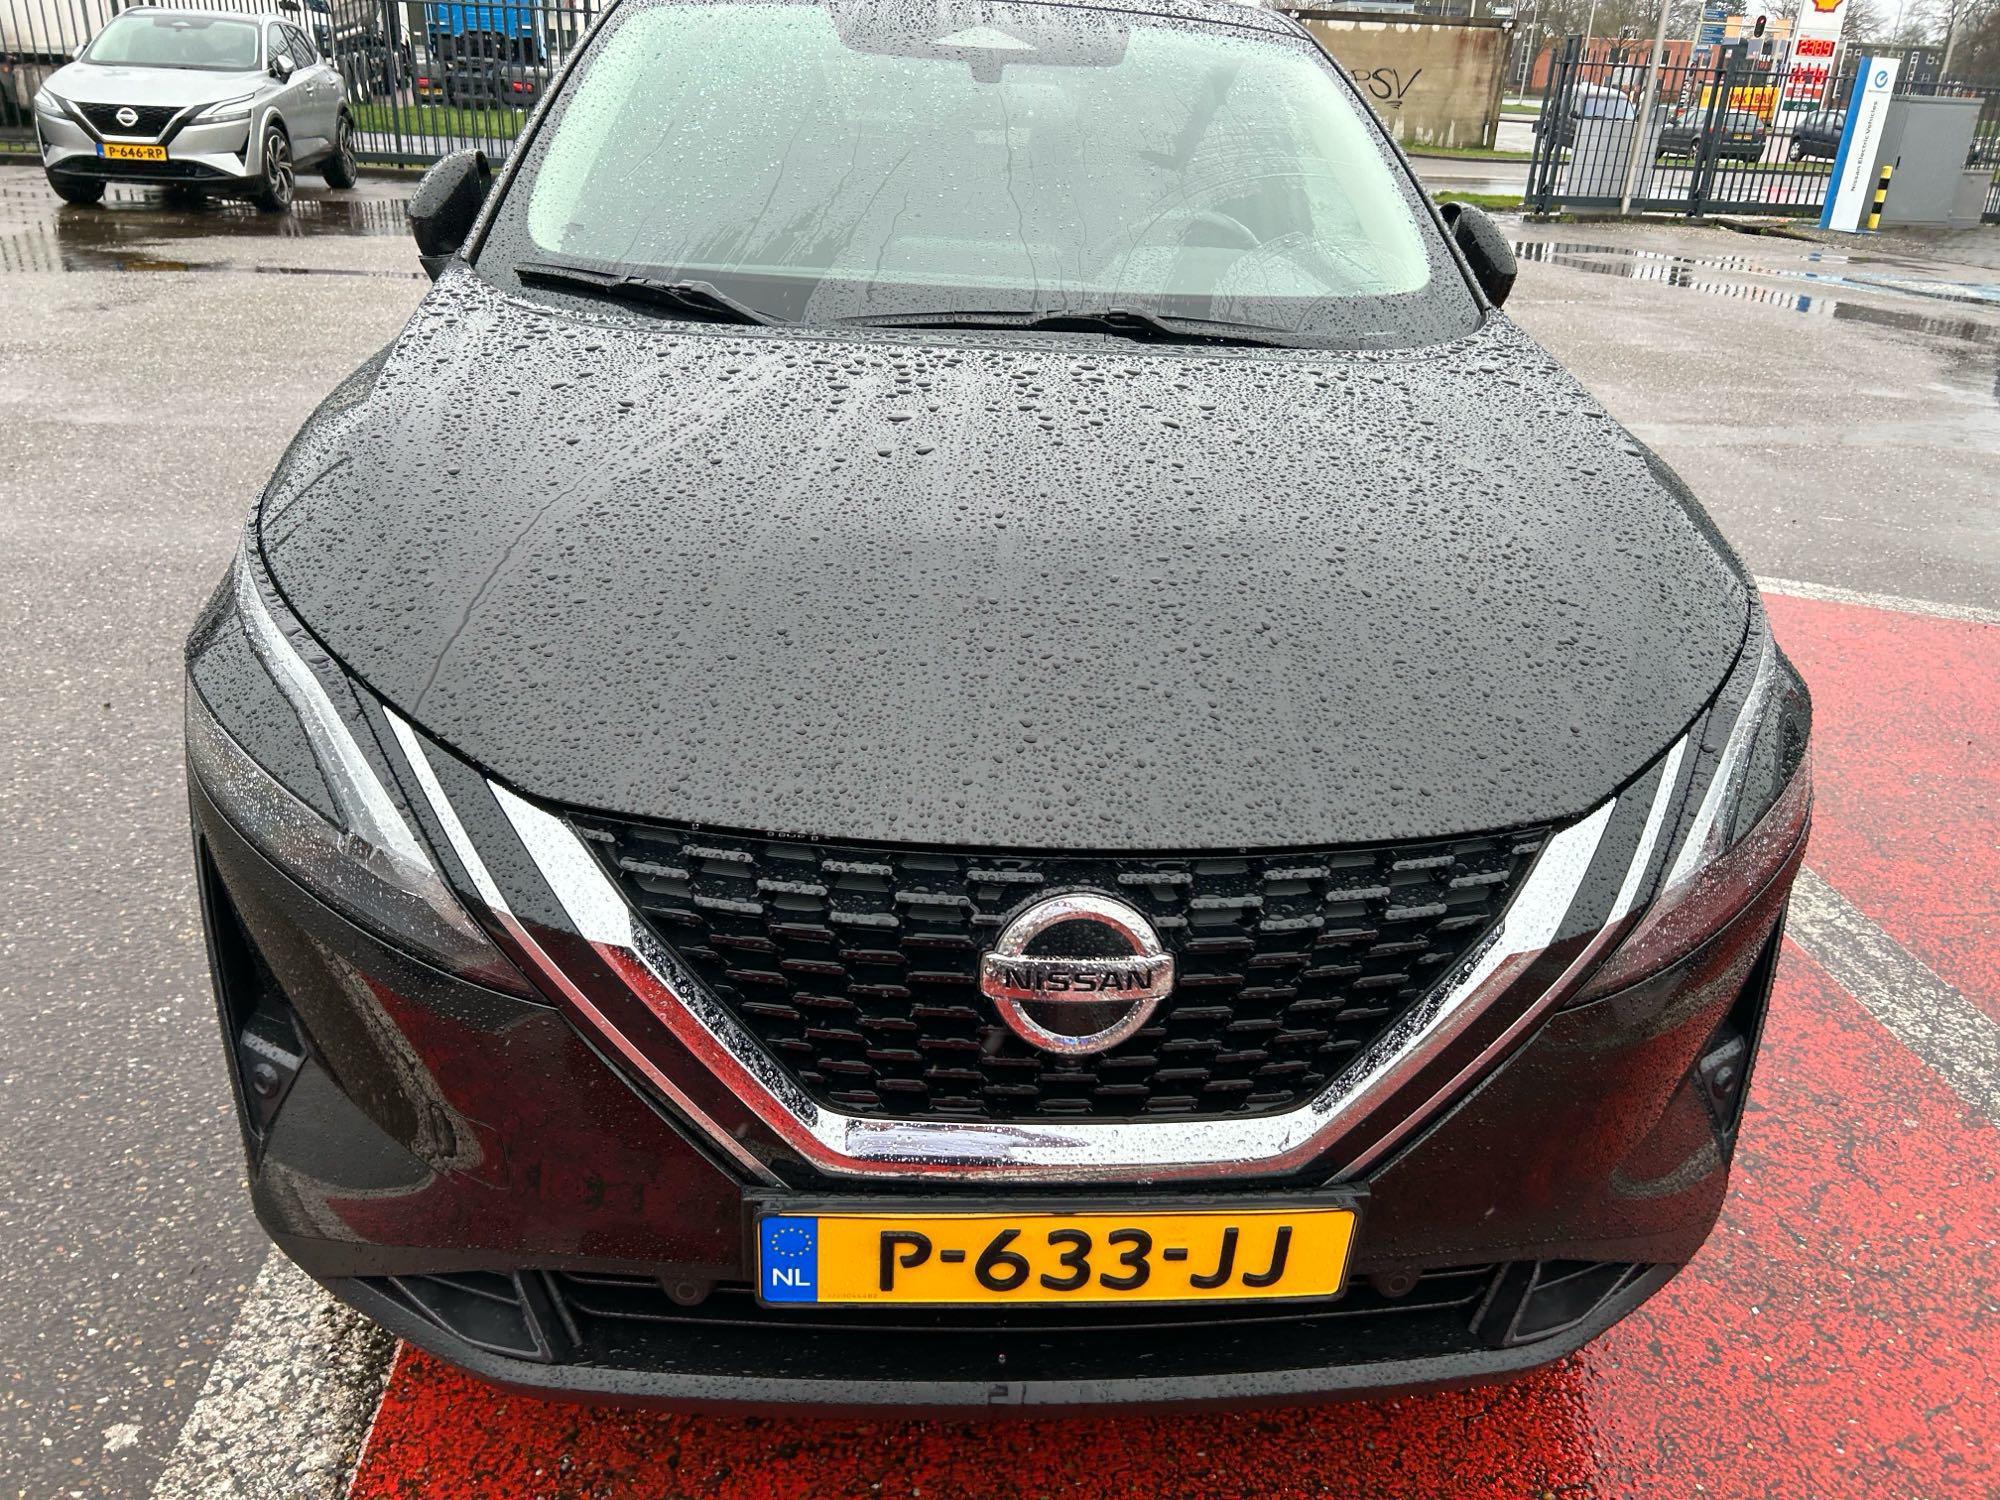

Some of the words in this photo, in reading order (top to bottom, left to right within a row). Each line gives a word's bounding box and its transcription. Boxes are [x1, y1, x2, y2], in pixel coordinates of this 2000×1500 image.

[1351, 67, 1422, 99] PSV
[1857, 134, 1870, 165] Electric
[1865, 101, 1878, 135] Vehicles
[109, 146, 163, 159] P-646-RP
[1004, 969, 1151, 992] NISSAN
[772, 1267, 811, 1287] NL
[878, 1226, 1292, 1292] P-633-JJ
